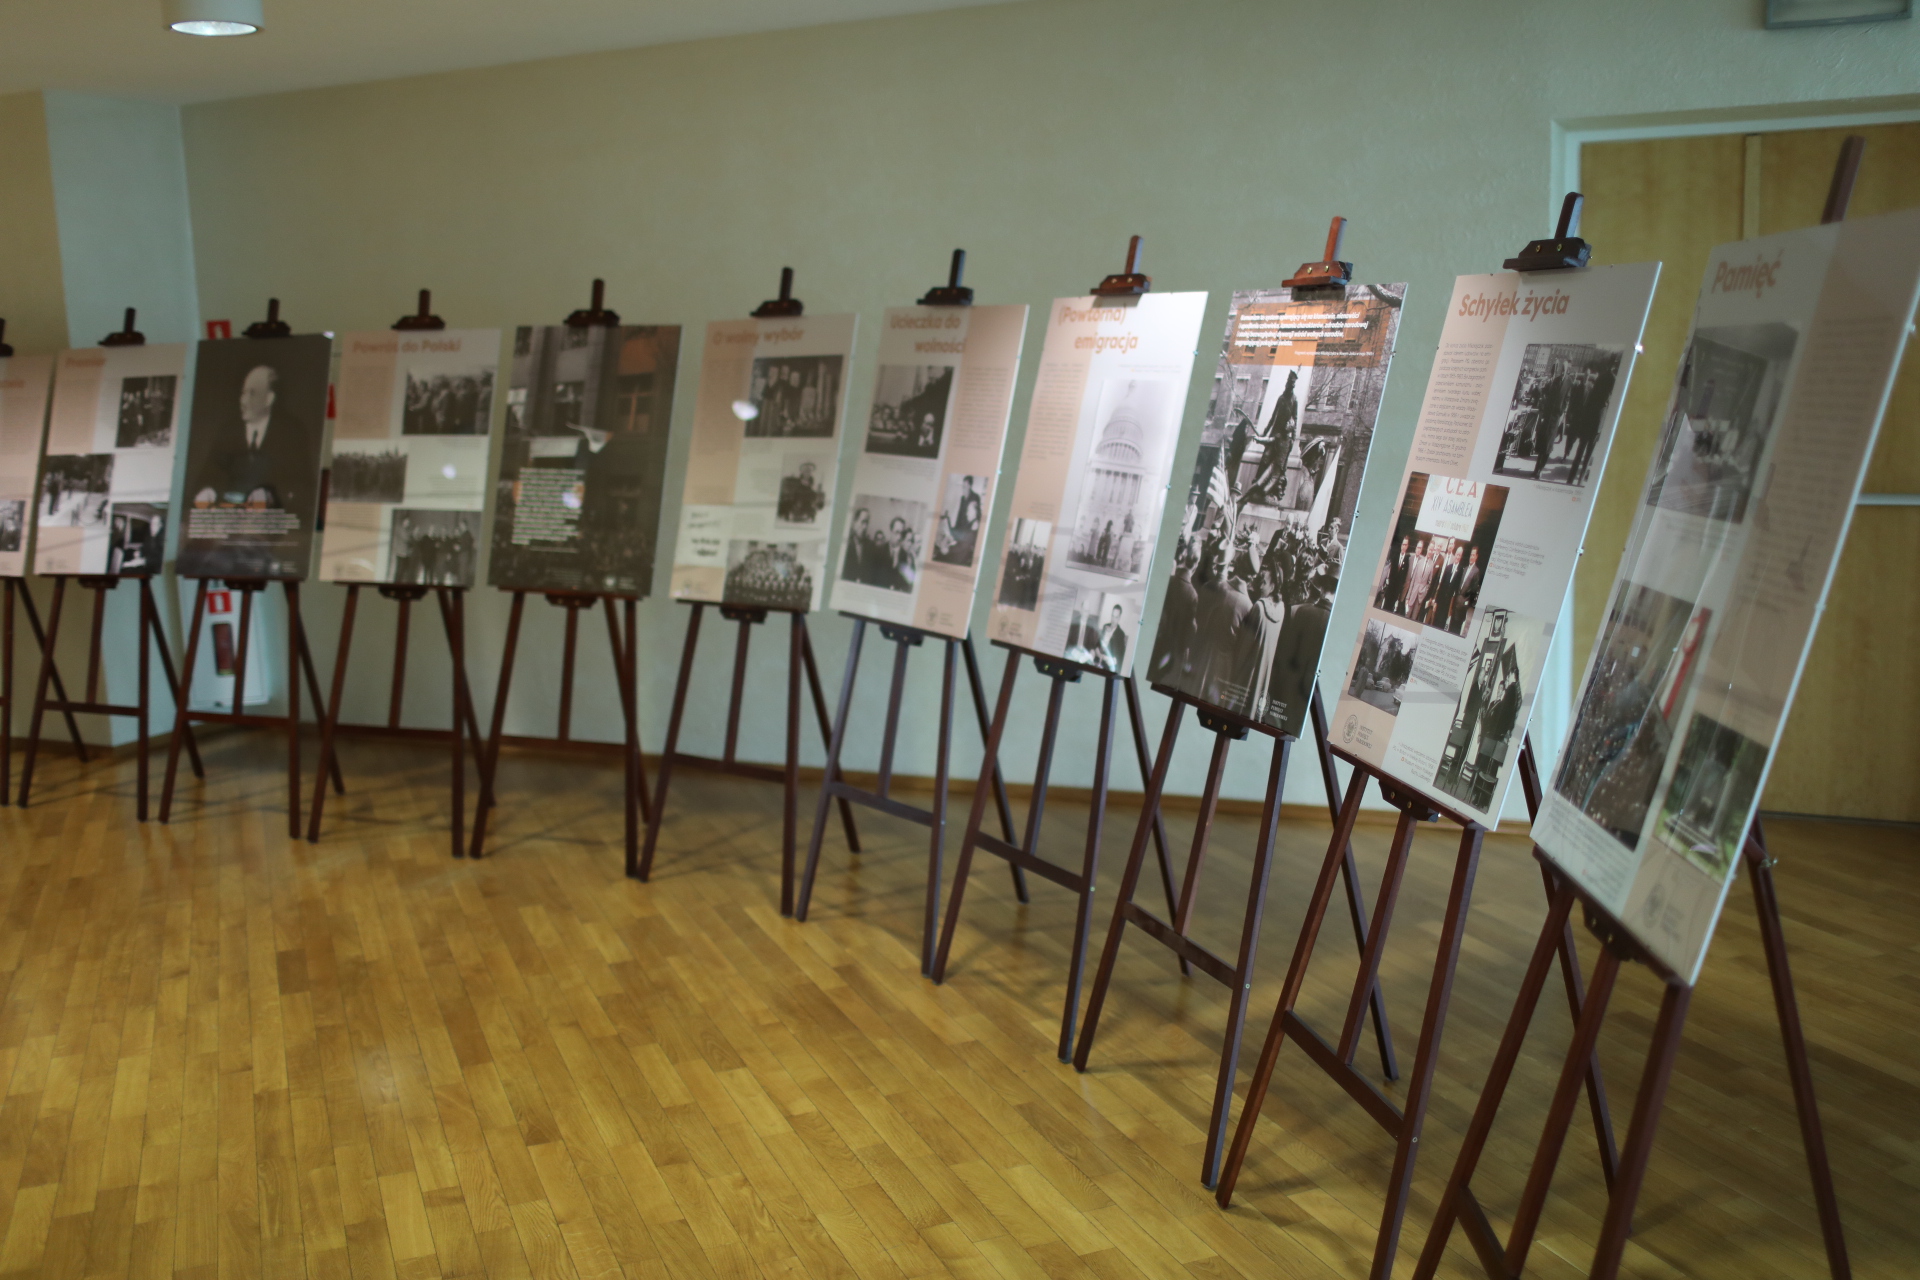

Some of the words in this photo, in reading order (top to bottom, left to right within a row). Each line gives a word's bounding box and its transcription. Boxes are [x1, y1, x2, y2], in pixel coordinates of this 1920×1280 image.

[1711, 247, 1784, 299] Pamięć
[1459, 287, 1520, 322] Schyłek
[1521, 288, 1570, 322] życia
[1074, 331, 1139, 354] emigracja
